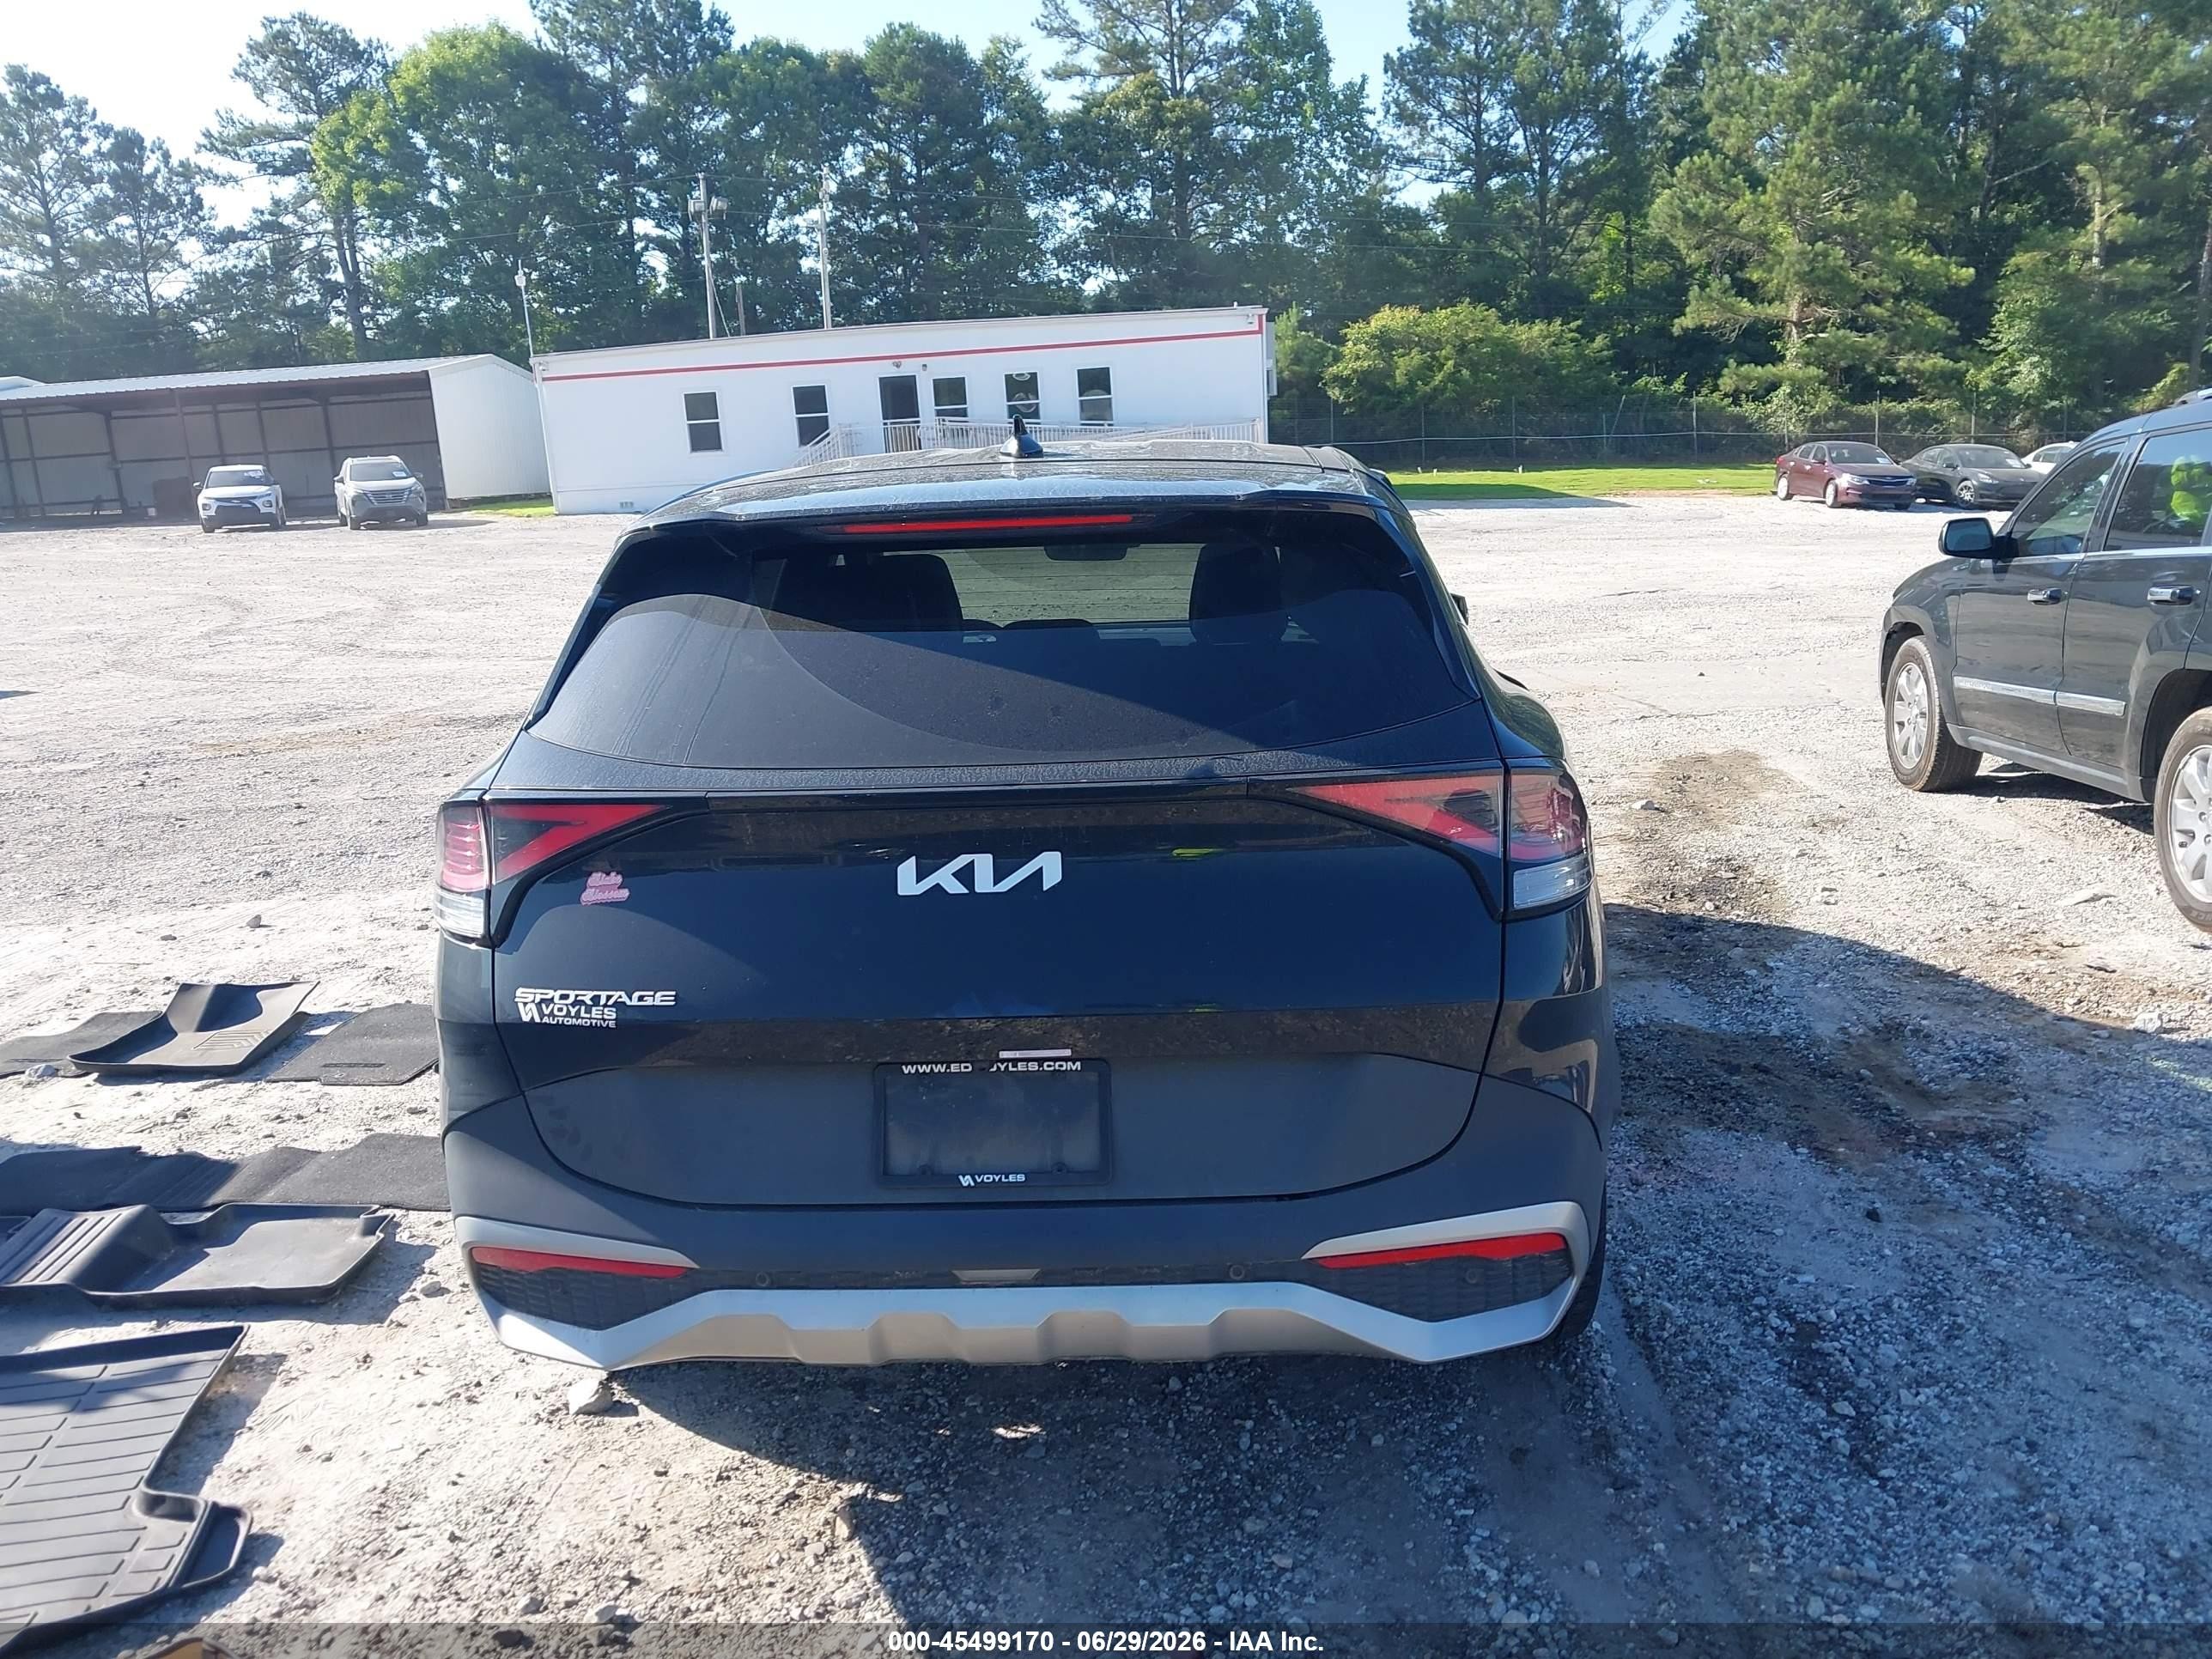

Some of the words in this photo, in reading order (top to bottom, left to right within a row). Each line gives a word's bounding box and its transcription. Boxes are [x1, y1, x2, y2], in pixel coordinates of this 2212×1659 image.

[896, 851, 1063, 896] KIA
[514, 986, 677, 1006] SPORTAGE
[541, 1002, 617, 1019] VOYLES
[541, 1017, 617, 1029] AUTOMOTIVE
[902, 1060, 1081, 1075] WWW.EDYLES.COM
[975, 1173, 1026, 1183] VOYLES
